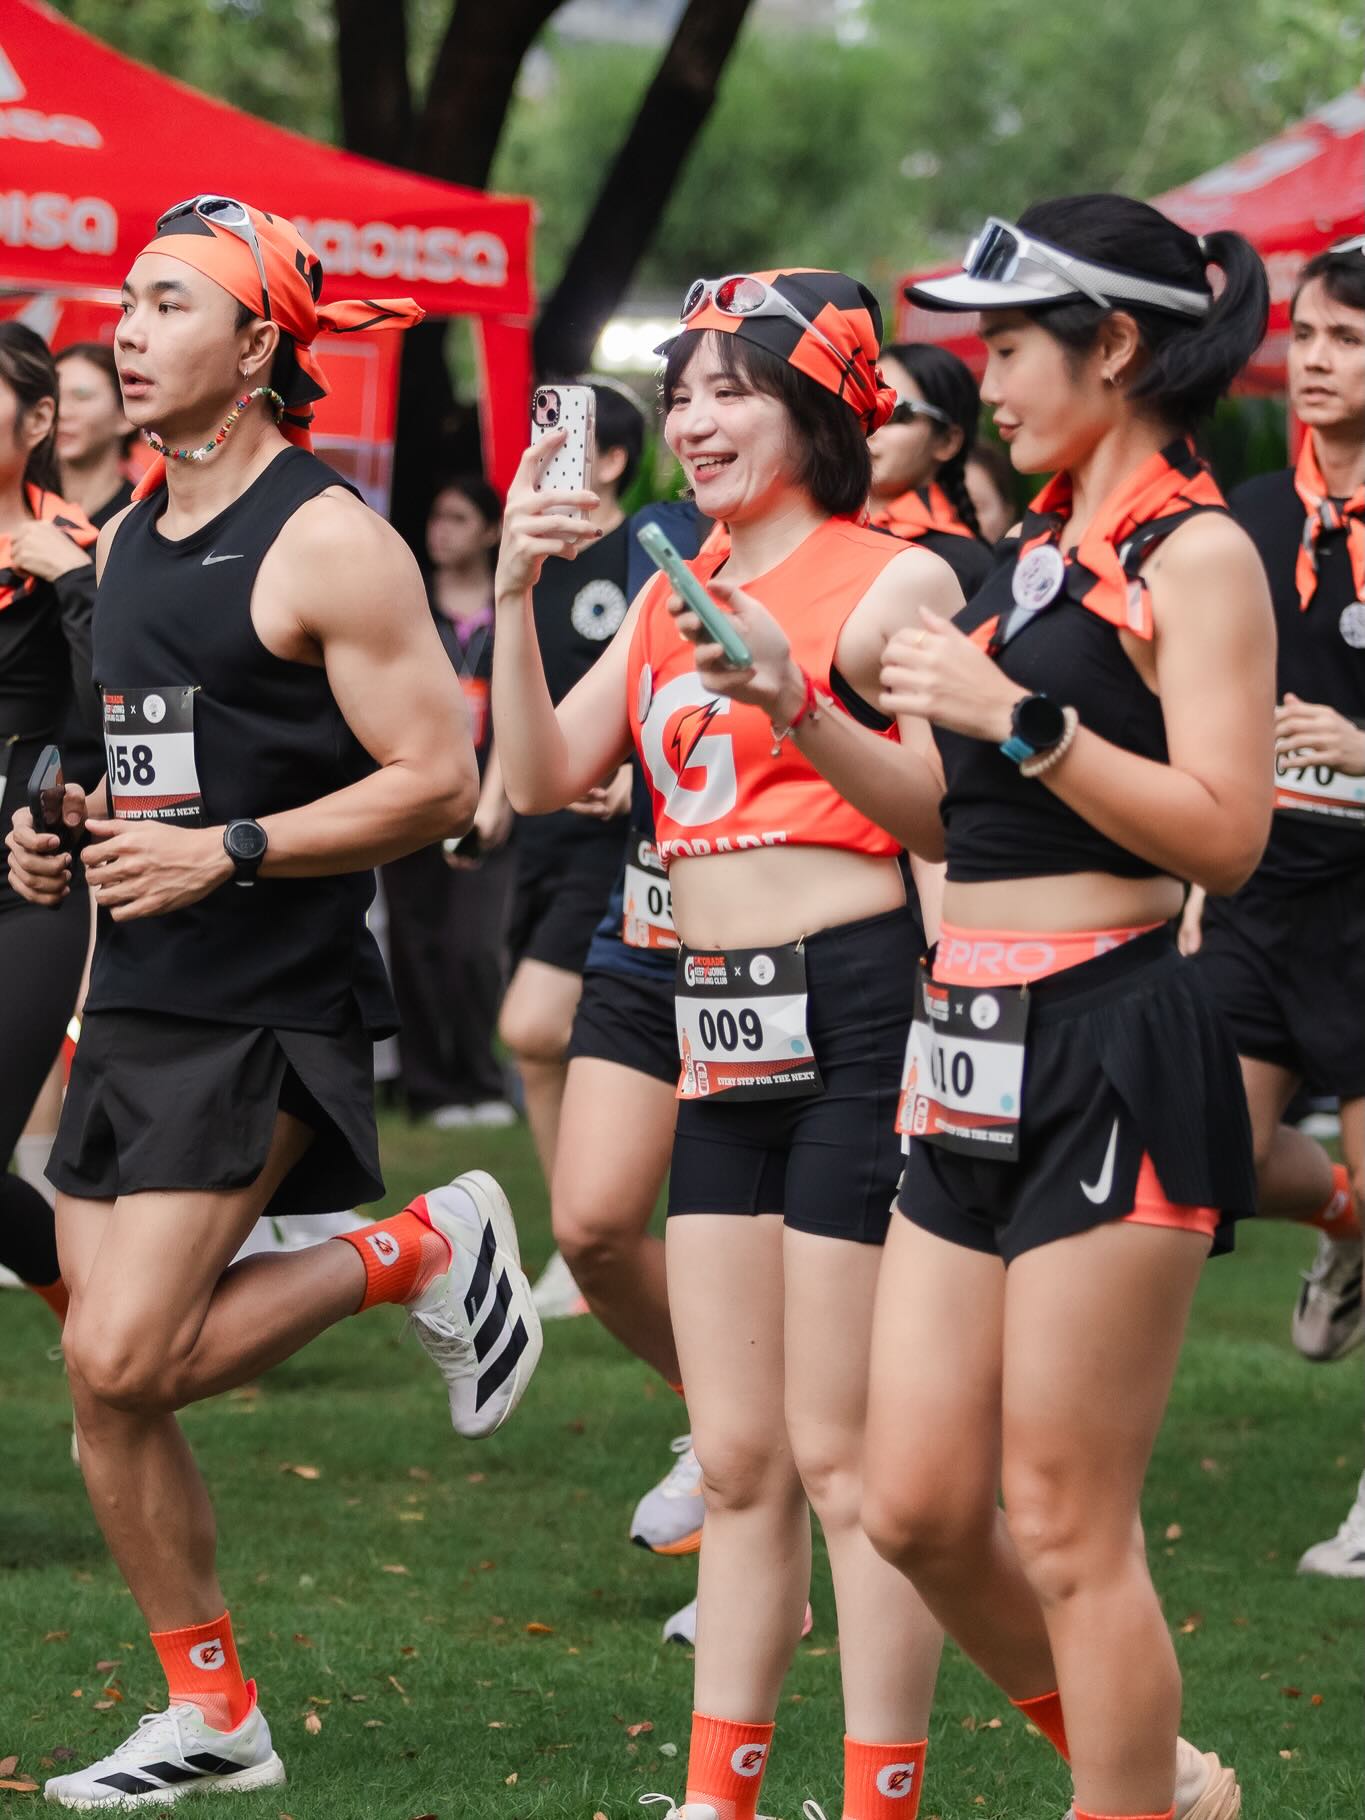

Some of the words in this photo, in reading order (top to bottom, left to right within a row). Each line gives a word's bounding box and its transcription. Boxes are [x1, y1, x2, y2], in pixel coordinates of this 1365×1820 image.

[108, 744, 156, 787] 058
[143, 810, 159, 818] FOR
[159, 808, 176, 817] THE
[176, 806, 200, 816] NEXT
[944, 940, 1056, 975] PRO
[699, 1008, 763, 1051] 009
[737, 1077, 755, 1086] STEP
[755, 1076, 772, 1085] FOR
[773, 1075, 791, 1084] THE
[791, 1071, 815, 1081] NEXT
